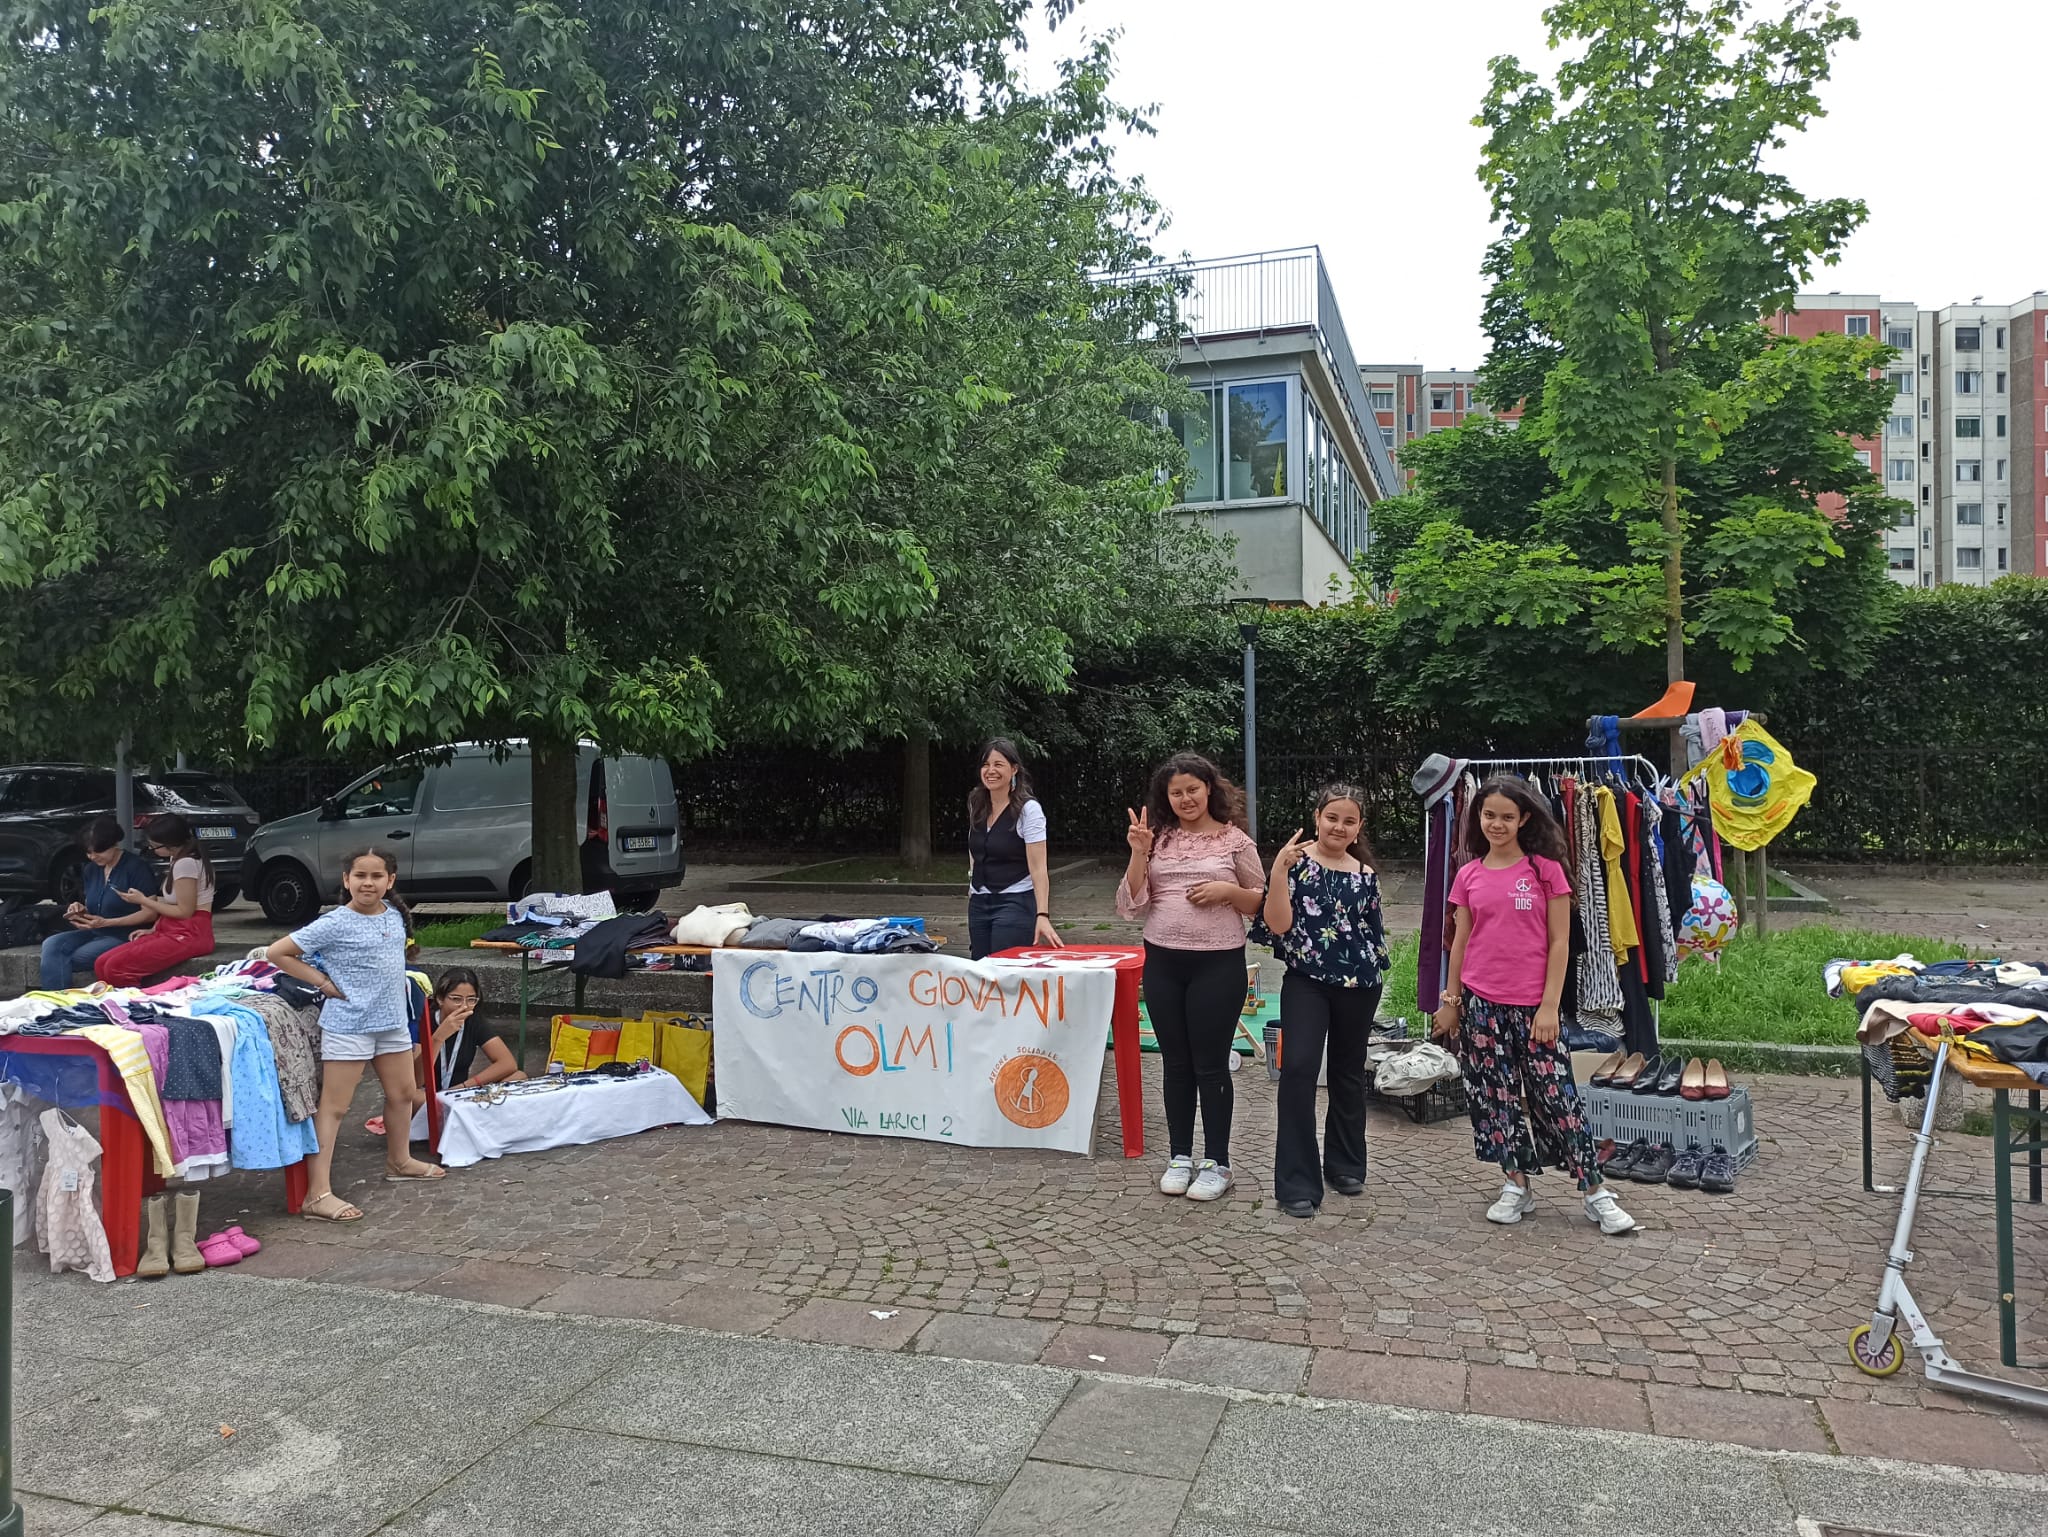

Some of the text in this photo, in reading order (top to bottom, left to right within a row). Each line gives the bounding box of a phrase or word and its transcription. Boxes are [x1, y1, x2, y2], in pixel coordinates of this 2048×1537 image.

[739, 960, 1065, 1028] CENTRO GIOVANI
[835, 1020, 954, 1076] OLMI
[1016, 1046, 1059, 1061] SOLIDALE
[841, 1106, 954, 1137] VIA LARICI 2
